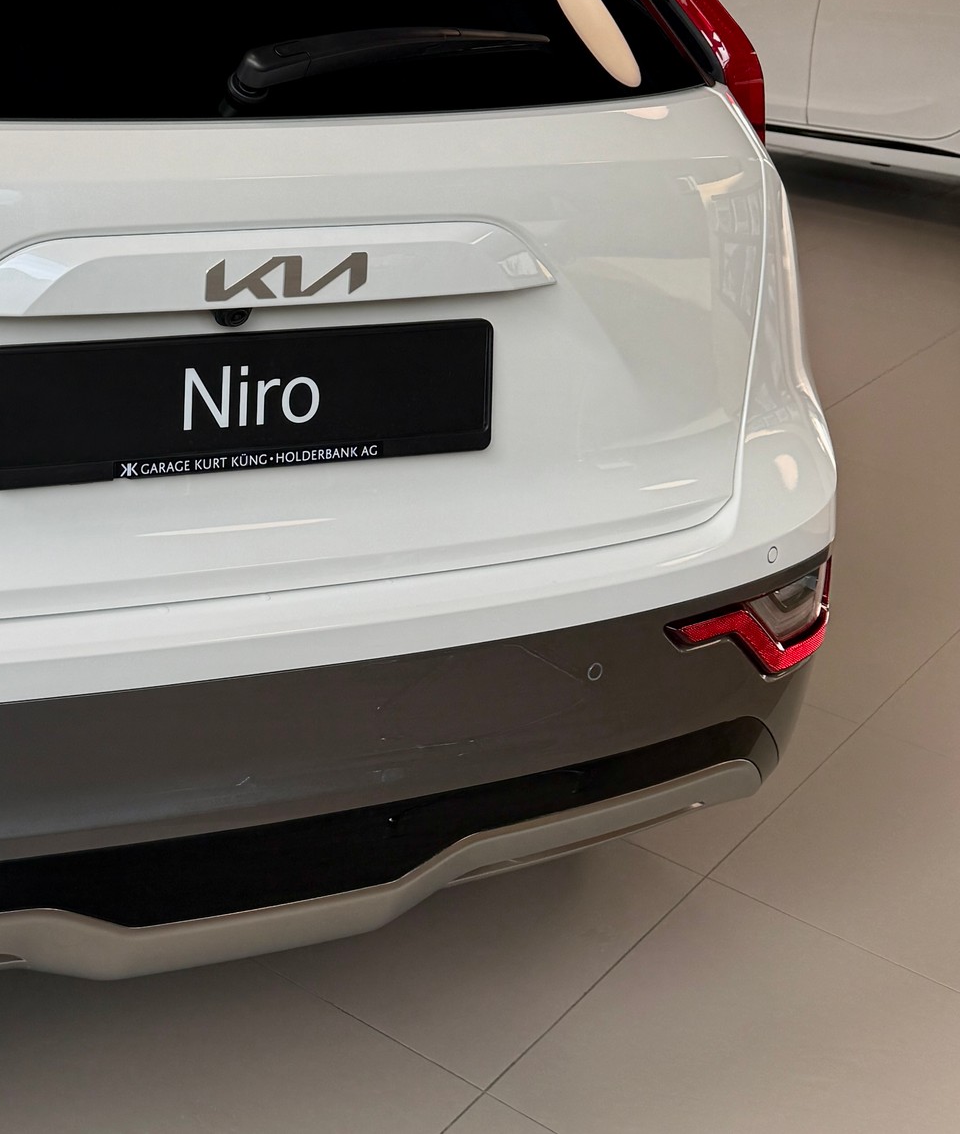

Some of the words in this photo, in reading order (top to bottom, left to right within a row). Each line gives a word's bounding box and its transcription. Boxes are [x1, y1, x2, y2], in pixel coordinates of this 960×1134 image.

[205, 251, 368, 303] KIA
[183, 364, 320, 432] Niro
[140, 460, 191, 475] GARAGE
[194, 457, 228, 471] KURT
[275, 446, 358, 464] HOLDERBANK
[361, 444, 378, 457] AG
